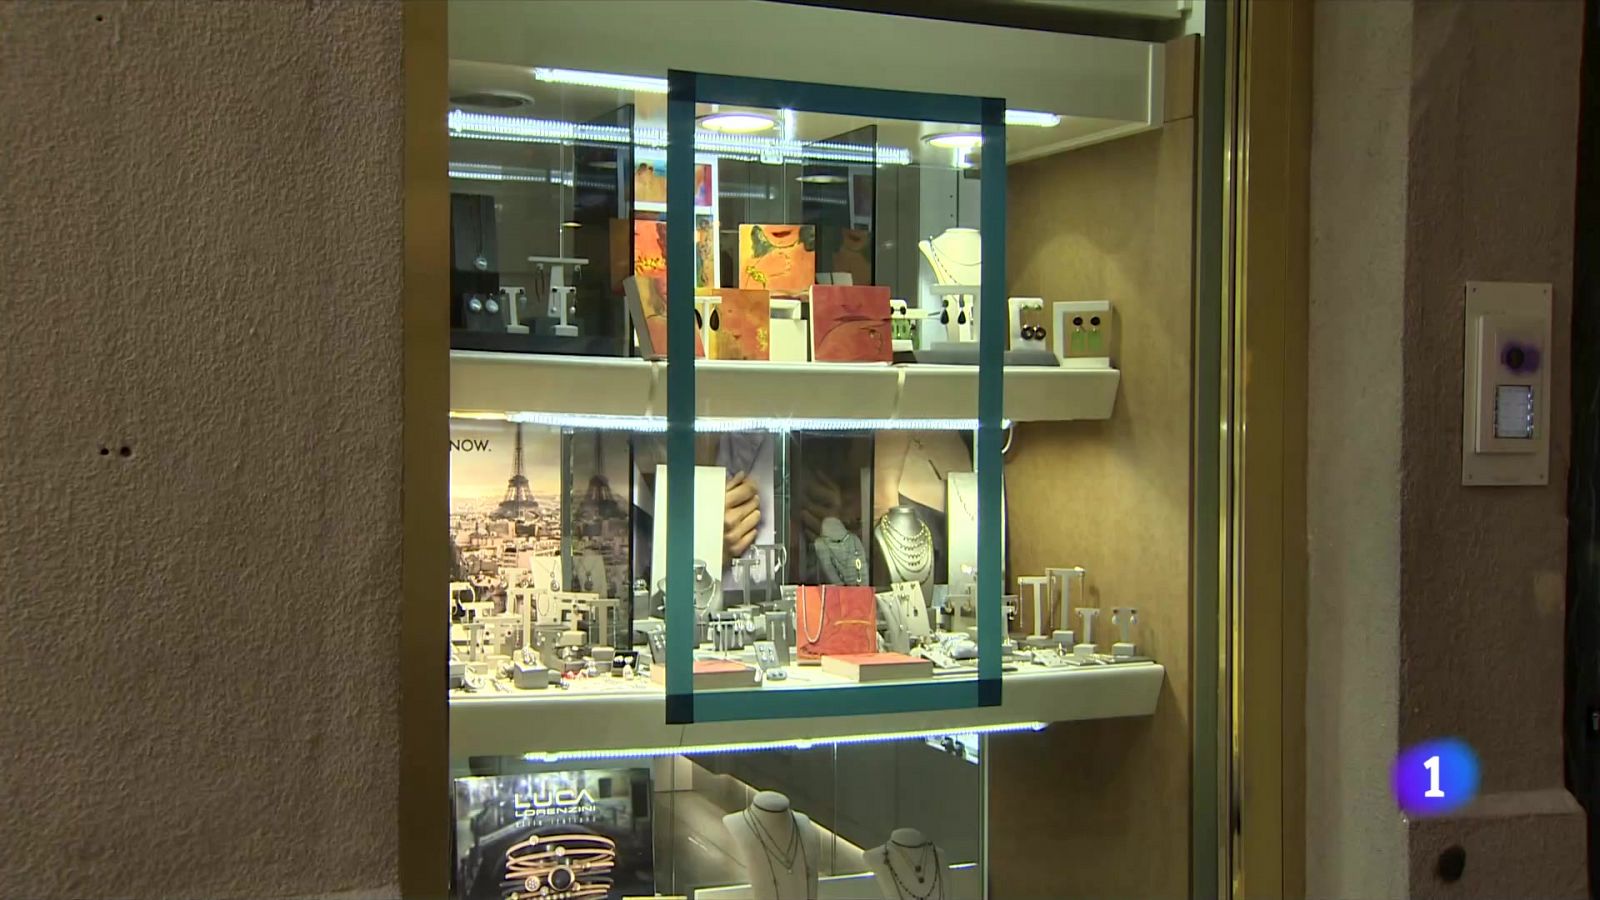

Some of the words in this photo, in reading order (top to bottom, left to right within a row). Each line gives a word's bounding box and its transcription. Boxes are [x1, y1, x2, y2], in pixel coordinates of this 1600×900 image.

[449, 439, 492, 452] NOW.
[514, 789, 595, 809] LUCA
[514, 805, 596, 818] LORENZINI
